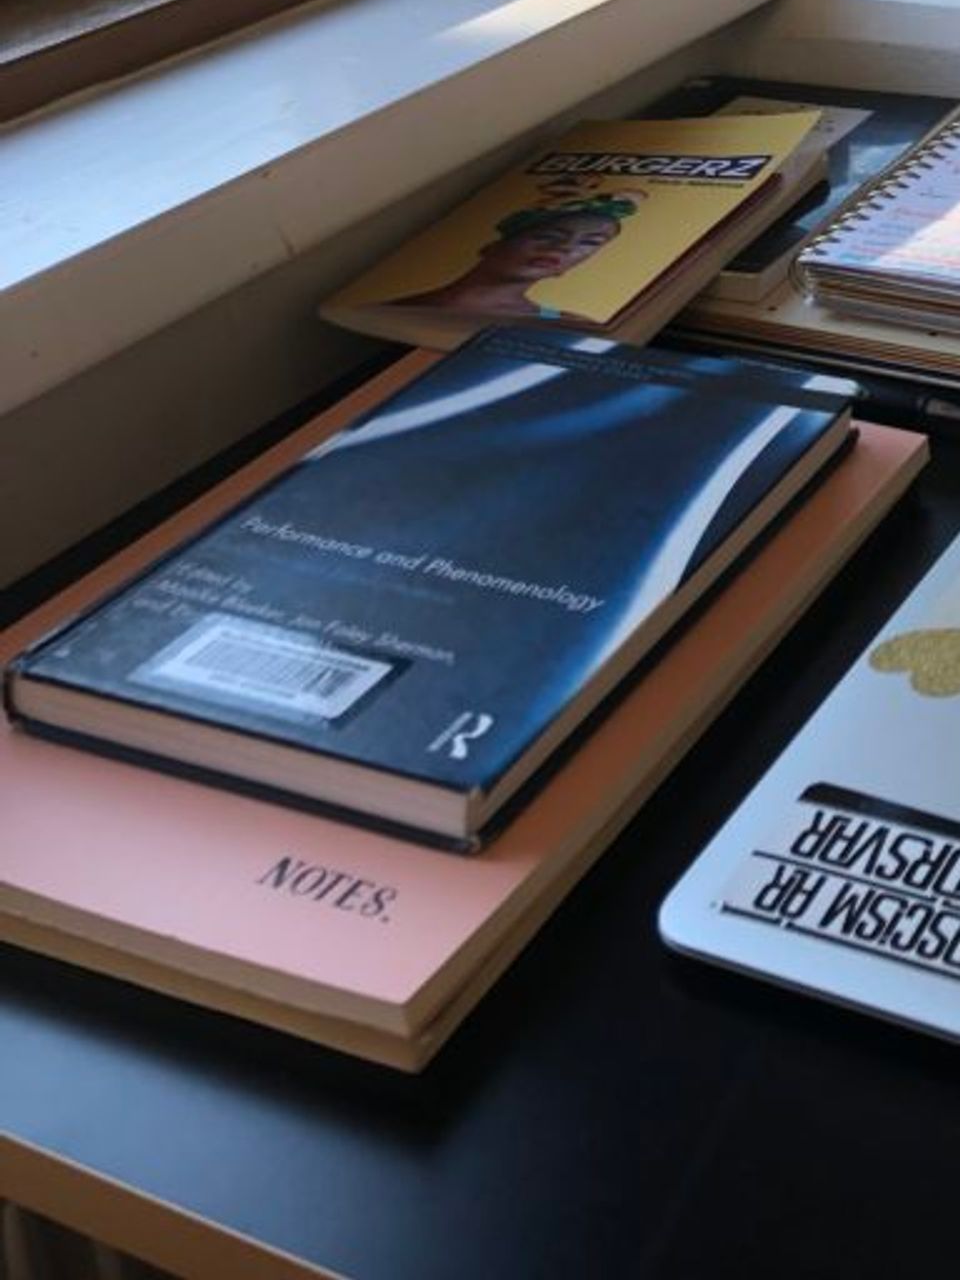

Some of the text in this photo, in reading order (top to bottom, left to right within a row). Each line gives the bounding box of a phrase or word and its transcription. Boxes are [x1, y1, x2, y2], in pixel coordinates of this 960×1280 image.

[535, 155, 767, 177] BURGERZ
[240, 517, 374, 558] Performance
[374, 549, 426, 571] and
[423, 557, 605, 613] Phenomenology
[255, 855, 398, 923] NOTES.
